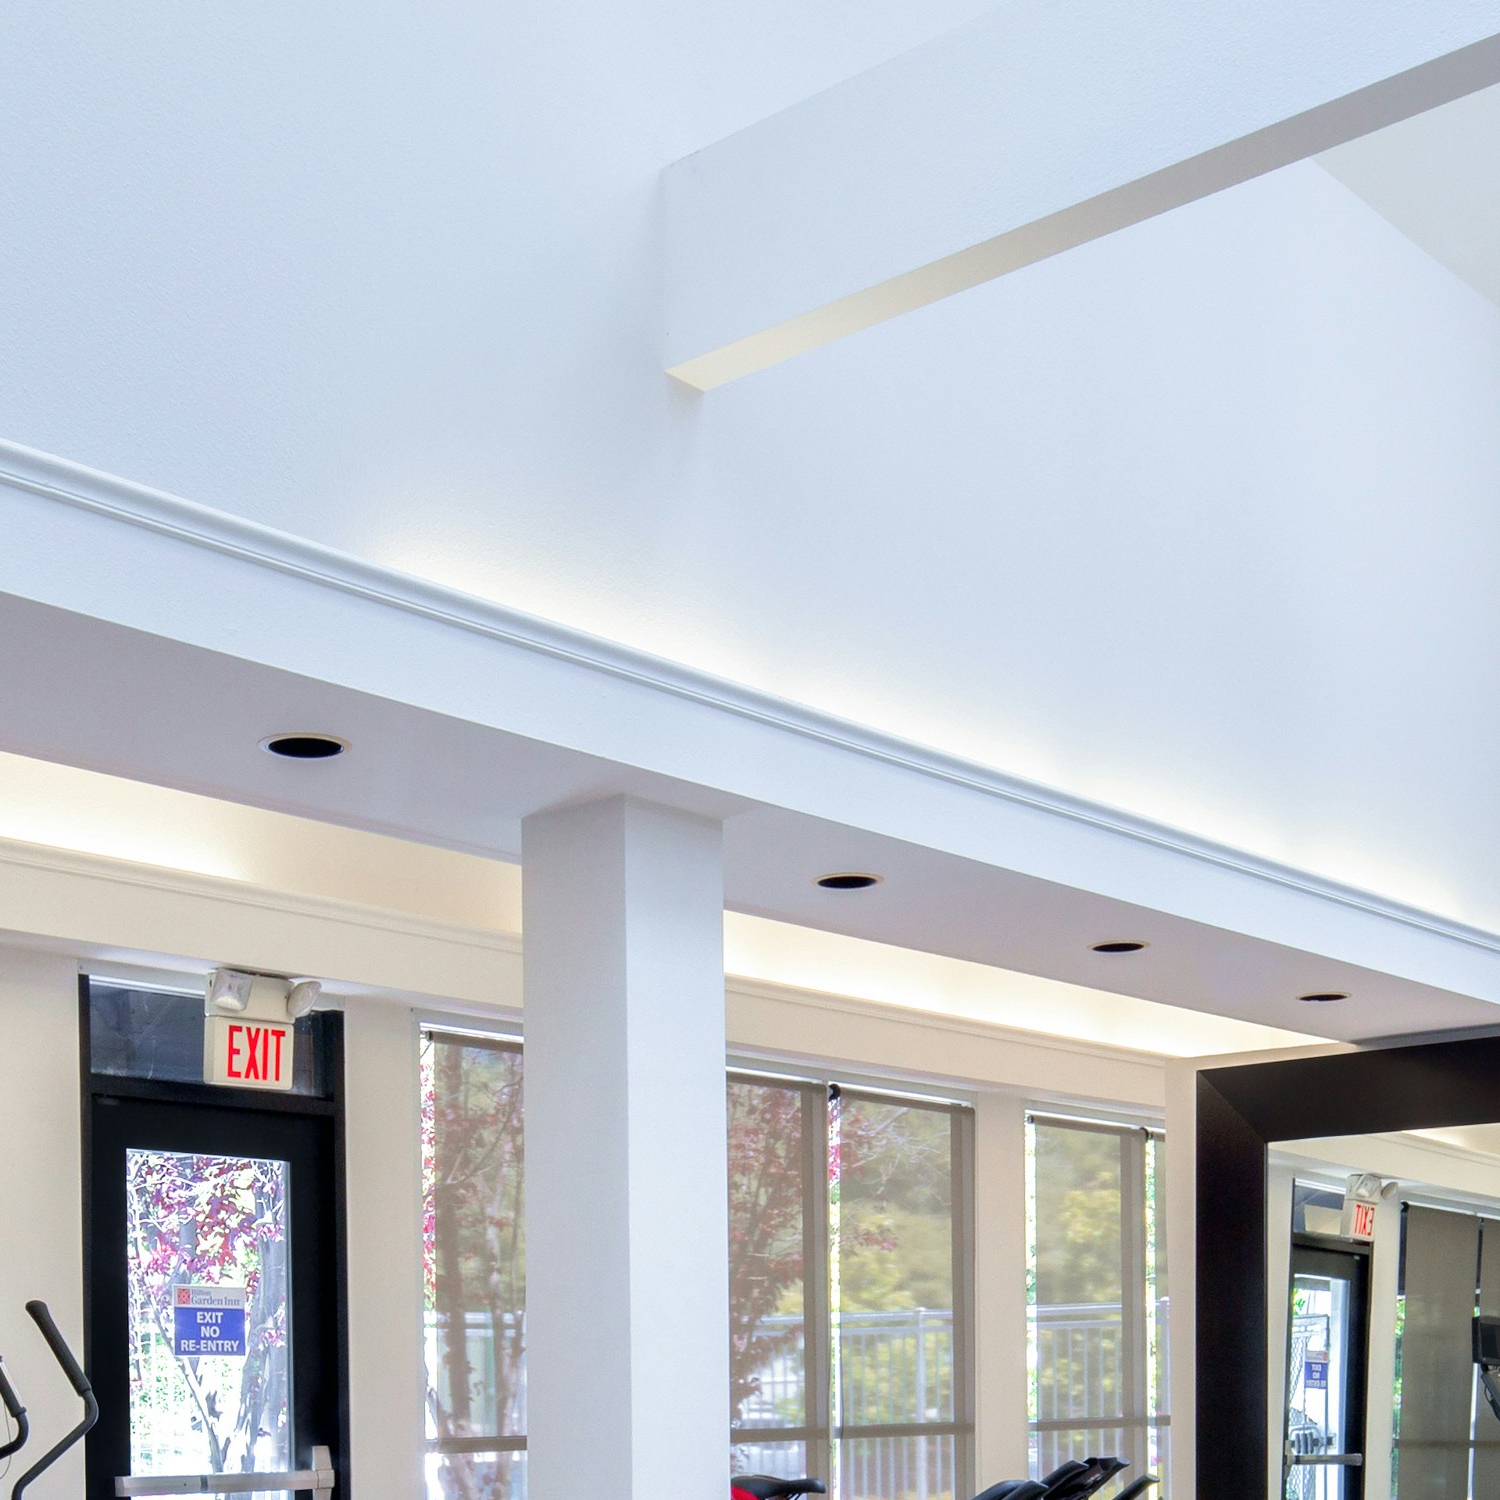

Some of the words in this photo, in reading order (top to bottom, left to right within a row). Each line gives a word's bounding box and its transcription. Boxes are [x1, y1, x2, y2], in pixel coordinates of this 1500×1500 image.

[227, 1025, 286, 1081] EXIT
[192, 1296, 223, 1306] Garden
[224, 1297, 240, 1306] Inn
[196, 1312, 224, 1324] EXIT
[200, 1326, 220, 1338] NO
[180, 1340, 240, 1352] RE-ENTRY
